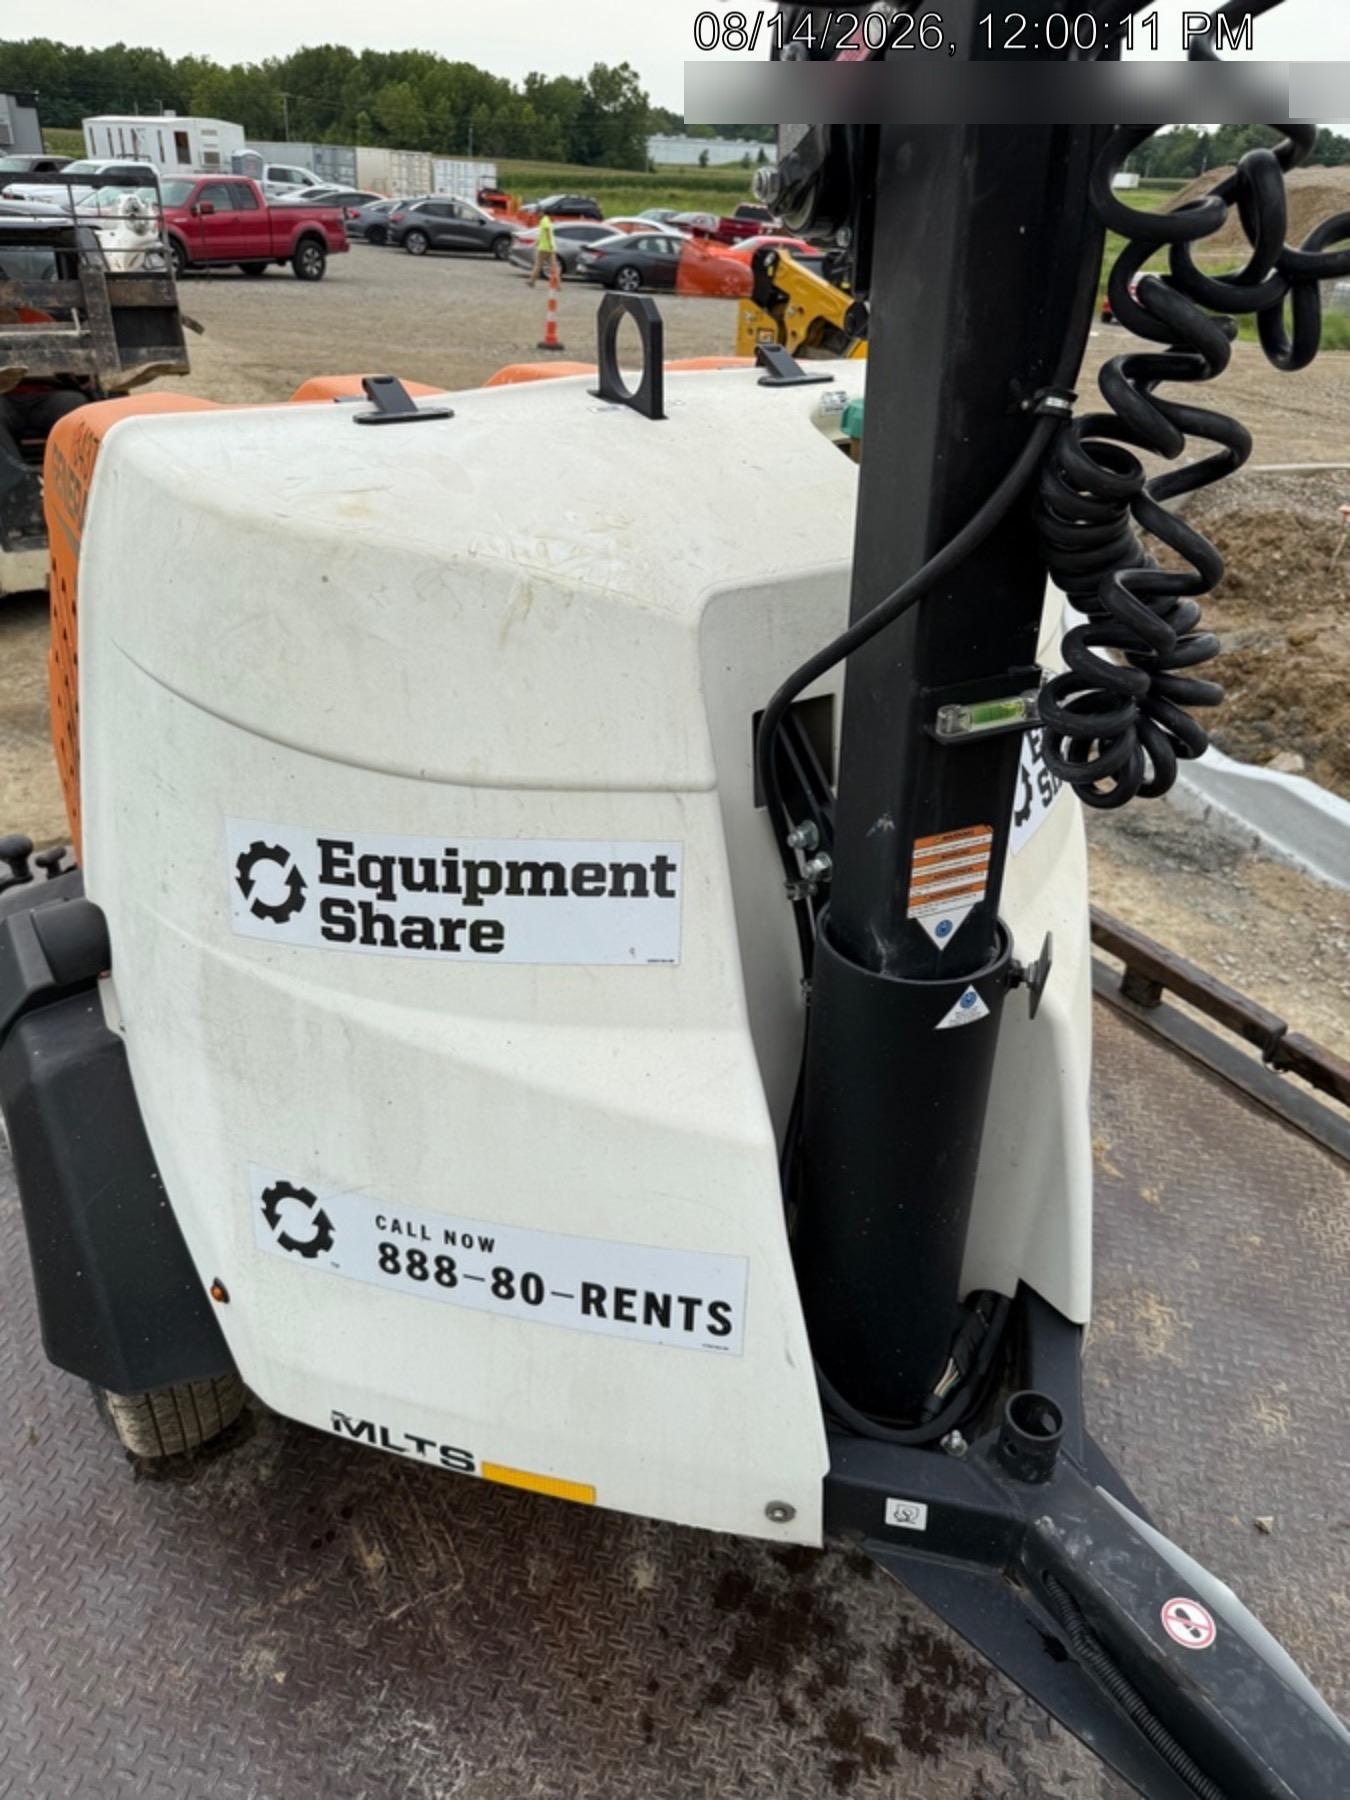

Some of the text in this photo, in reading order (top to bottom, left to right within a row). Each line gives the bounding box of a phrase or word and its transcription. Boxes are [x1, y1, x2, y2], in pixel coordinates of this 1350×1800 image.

[316, 838, 677, 907] Equipment
[319, 897, 505, 954] Share
[375, 1214, 496, 1253] CALL NOW
[331, 1410, 476, 1472] MLTS
